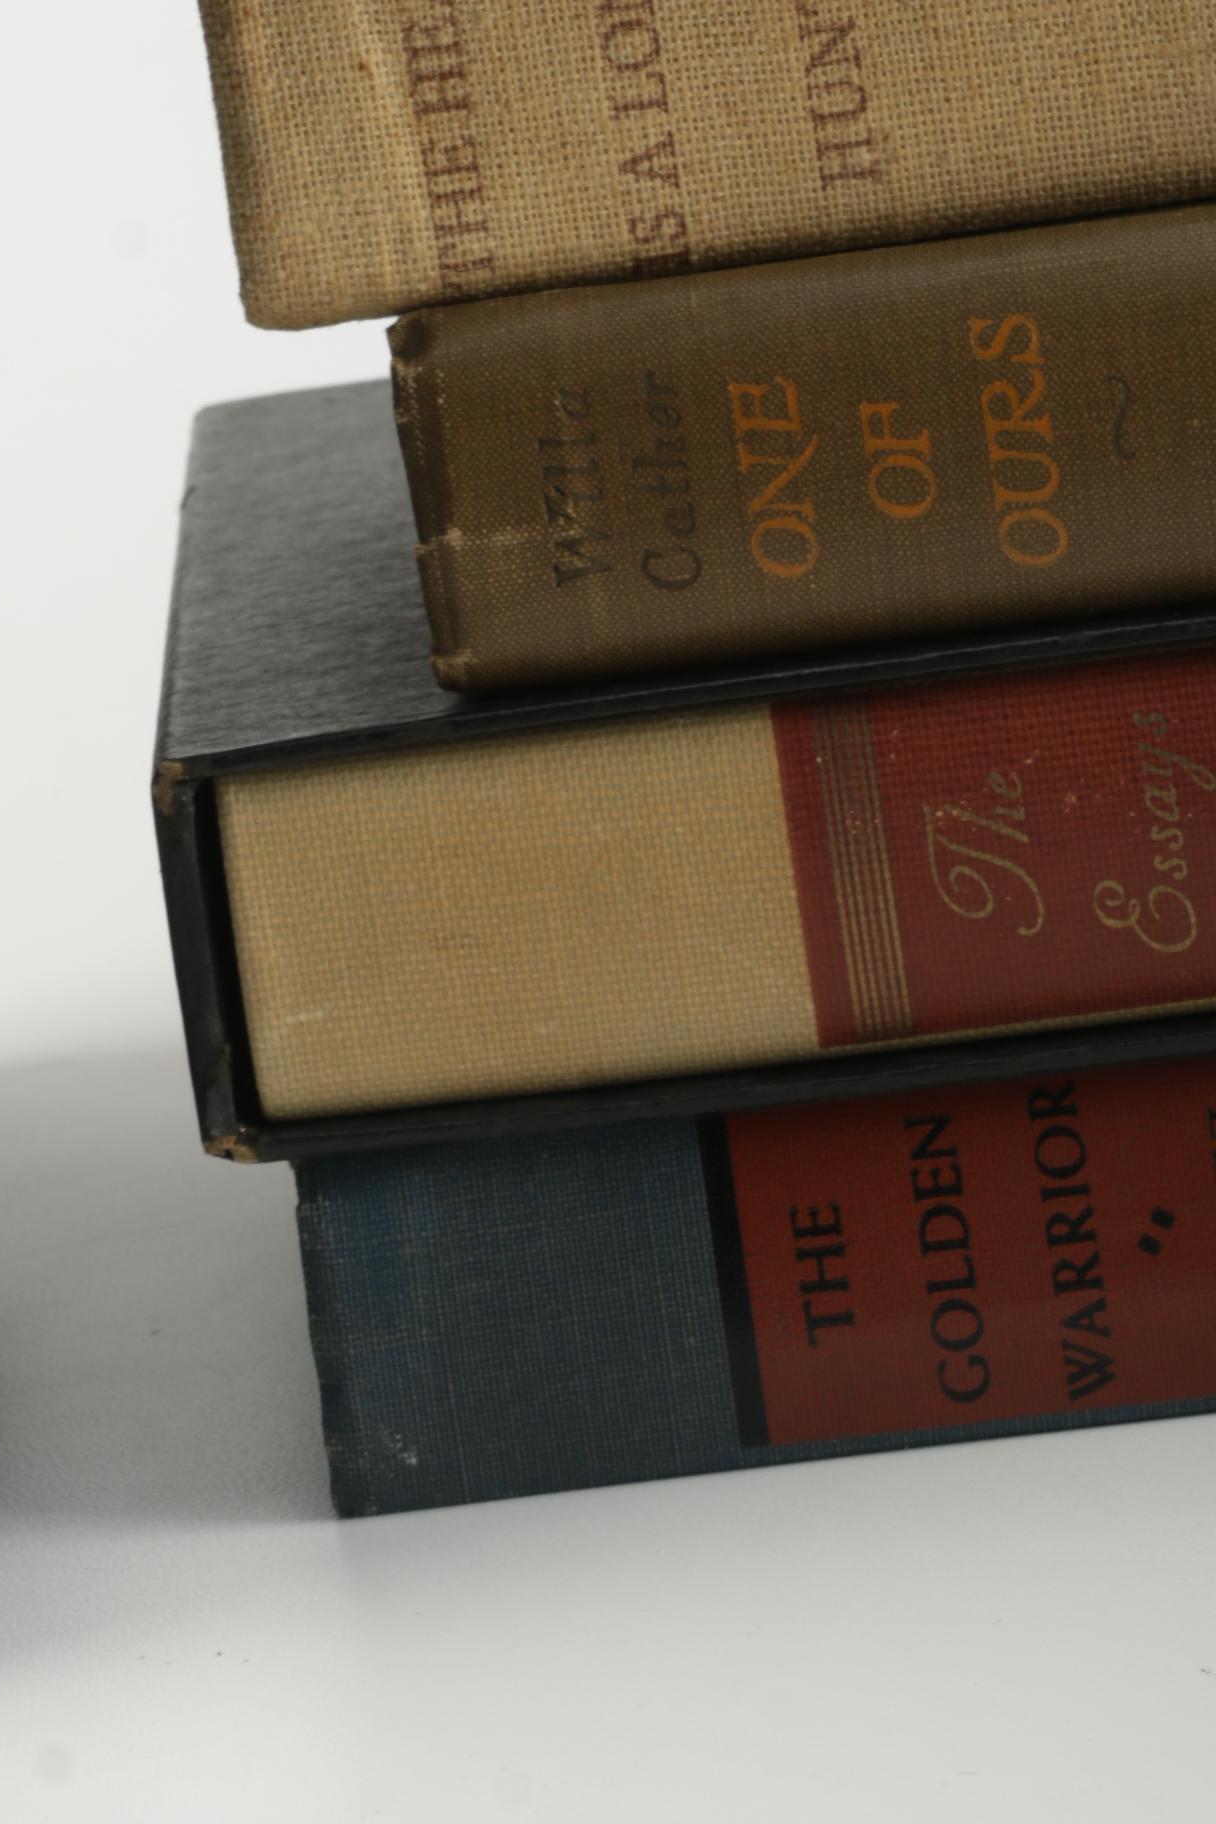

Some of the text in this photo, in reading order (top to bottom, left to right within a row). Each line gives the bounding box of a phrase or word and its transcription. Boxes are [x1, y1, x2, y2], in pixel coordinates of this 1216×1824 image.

[421, 136, 496, 290] THE
[618, 130, 680, 189] A
[728, 376, 819, 577] ONE
[860, 401, 937, 520] OF
[970, 312, 1069, 567] OURS
[923, 771, 1044, 935] The
[1094, 711, 1216, 952] Essays
[789, 1199, 855, 1348] THE
[904, 1113, 991, 1403] GOLDEN
[1028, 1079, 1116, 1402] WARRIOR
